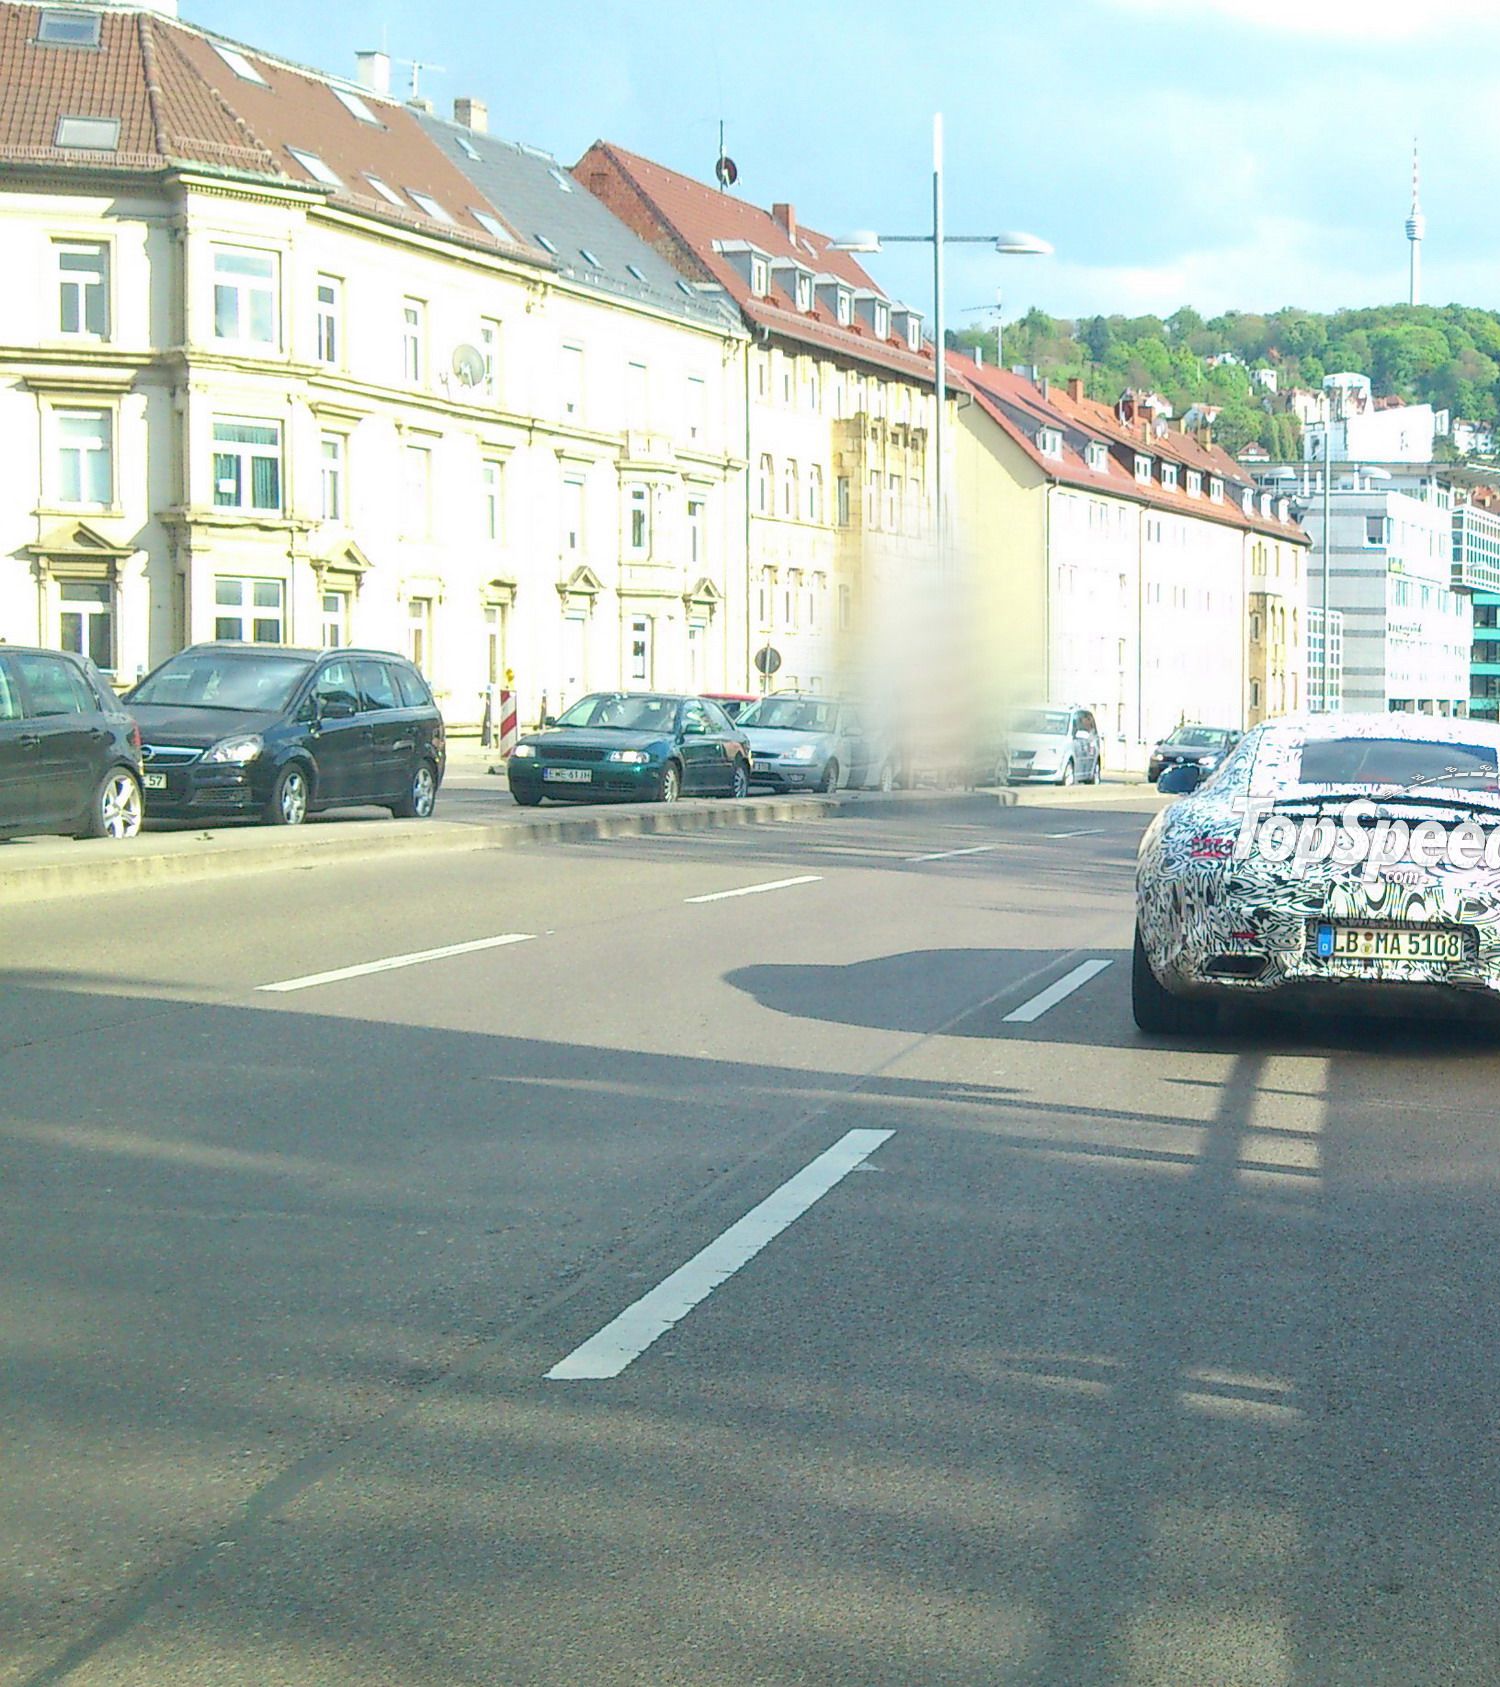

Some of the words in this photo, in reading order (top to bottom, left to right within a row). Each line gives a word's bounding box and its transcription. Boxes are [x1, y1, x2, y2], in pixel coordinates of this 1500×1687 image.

[1333, 927, 1358, 953] LB
[1375, 932, 1401, 955] MA
[1408, 933, 1459, 957] 5108
